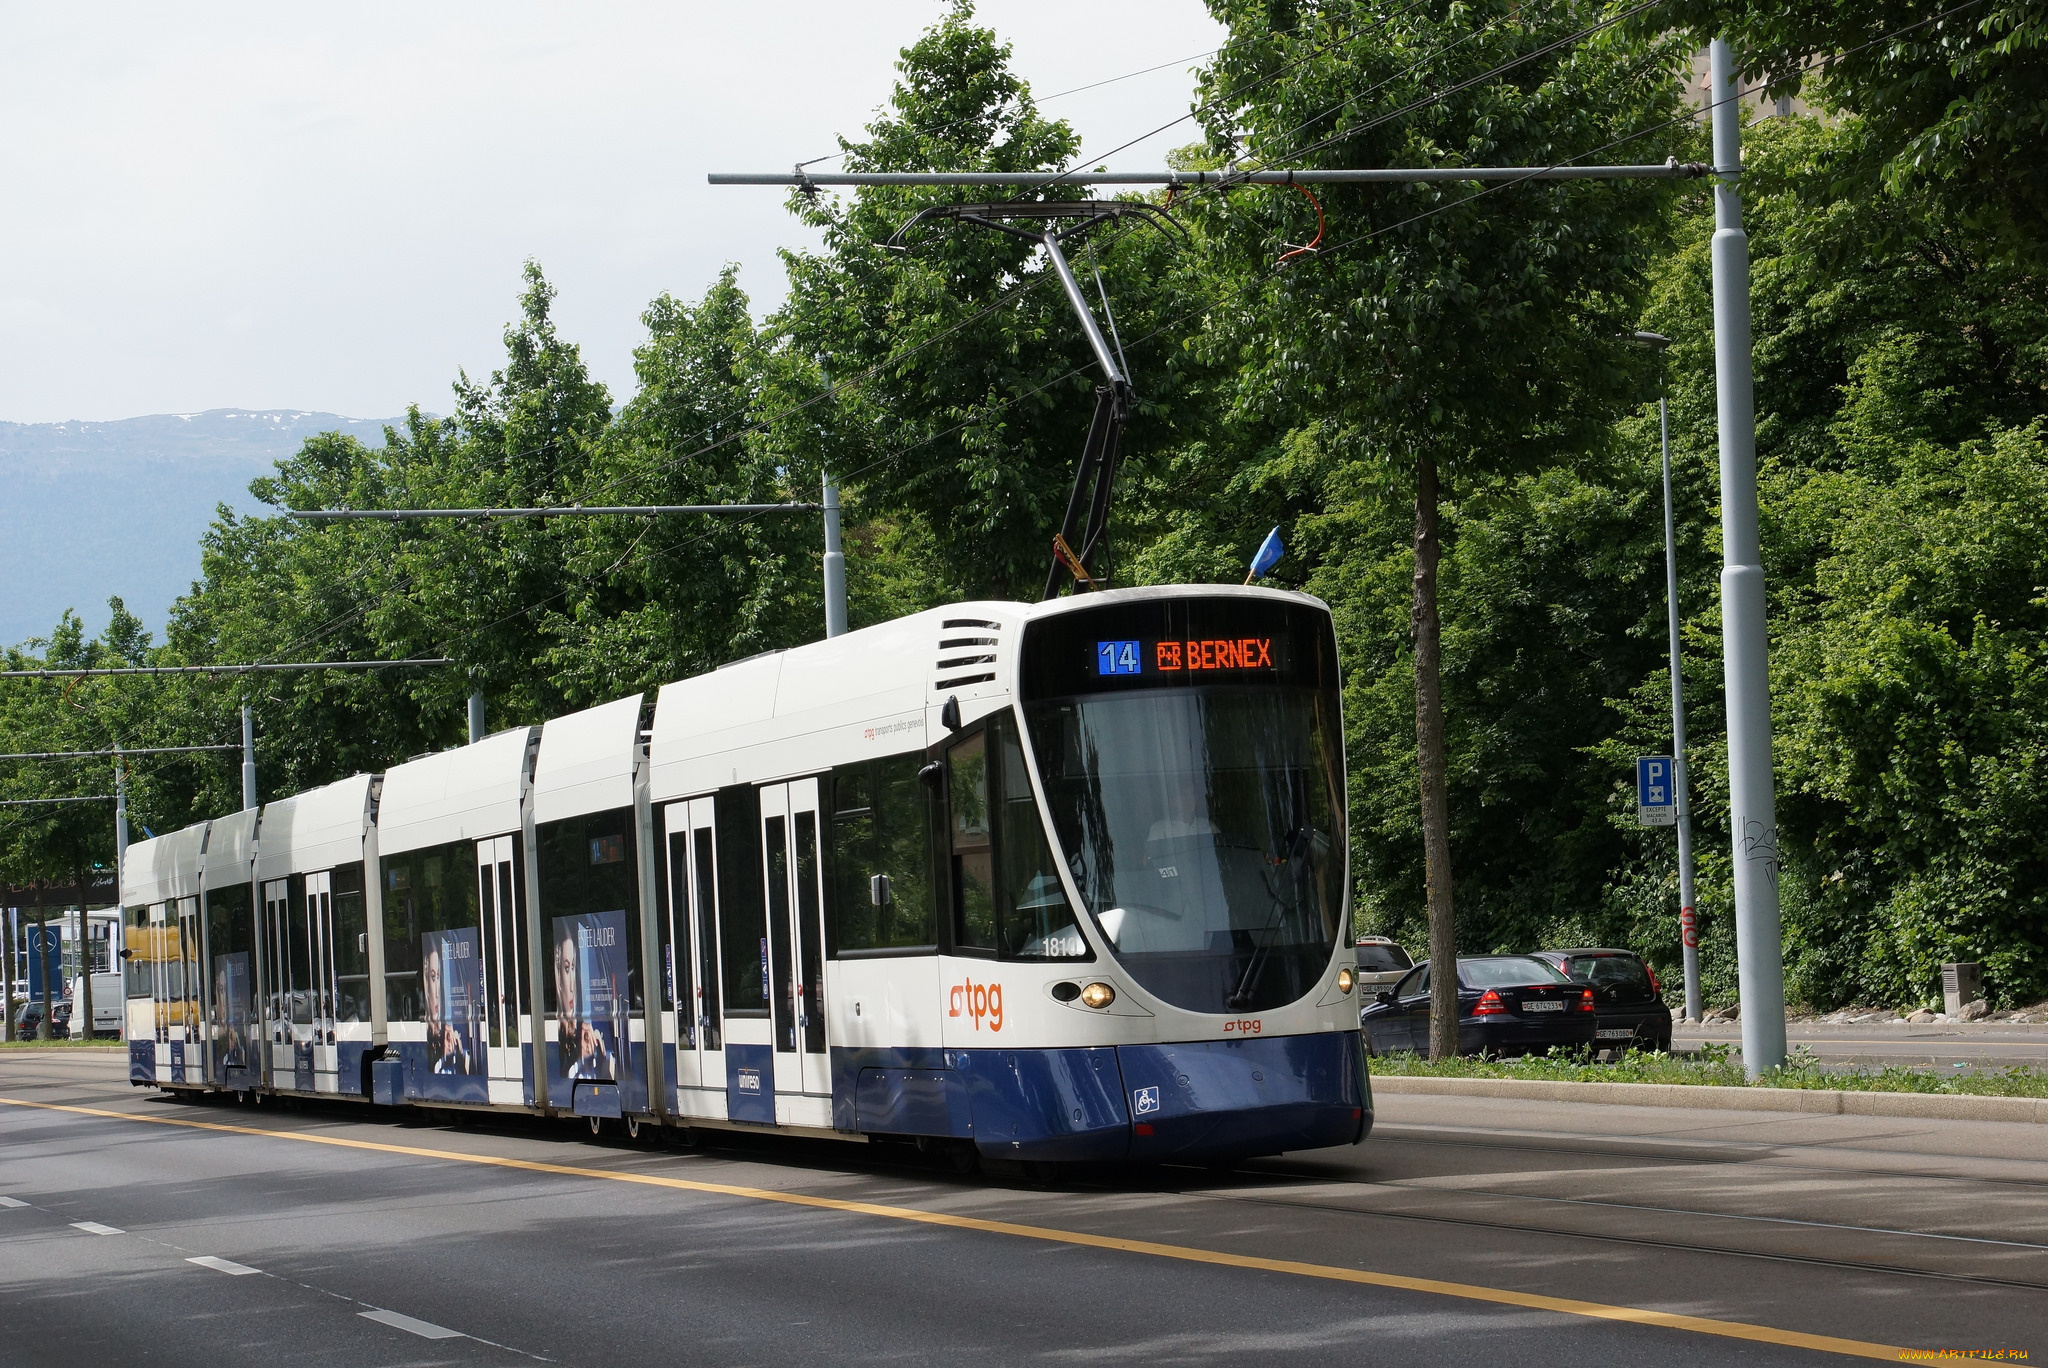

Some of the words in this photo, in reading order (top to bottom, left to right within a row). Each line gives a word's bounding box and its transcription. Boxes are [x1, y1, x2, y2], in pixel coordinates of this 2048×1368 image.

[1101, 643, 1137, 672] 14
[1187, 639, 1271, 670] BERNEX
[875, 723, 893, 737] transports
[893, 719, 907, 735] publics
[907, 716, 924, 733] genevois
[1649, 762, 1663, 785] P
[593, 927, 615, 948] LAUDER
[1043, 937, 1077, 957] 1810
[966, 977, 1003, 1032] tpg
[1527, 1002, 1535, 1010] GE
[1237, 1019, 1262, 1034] tpg
